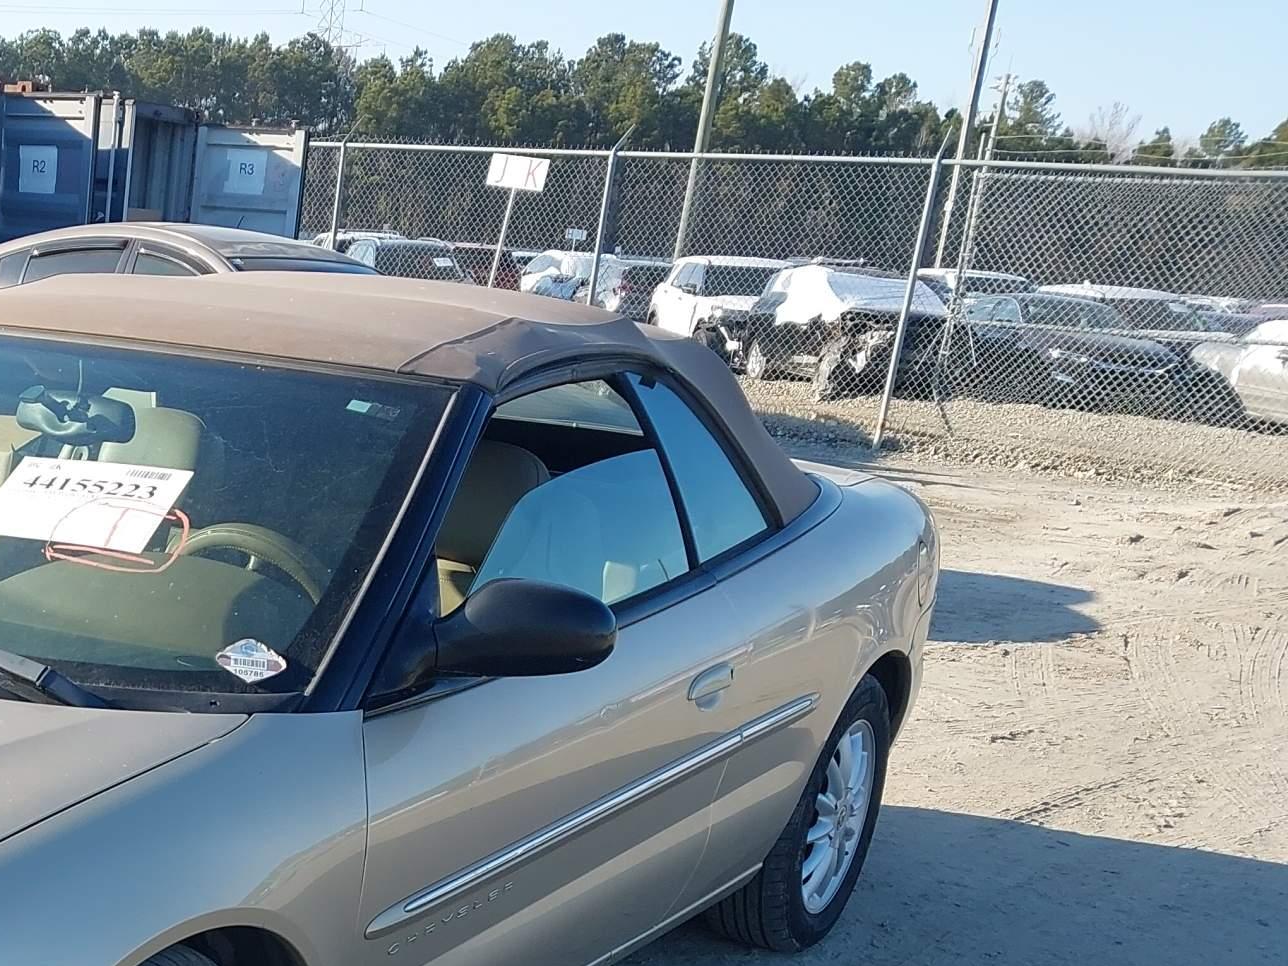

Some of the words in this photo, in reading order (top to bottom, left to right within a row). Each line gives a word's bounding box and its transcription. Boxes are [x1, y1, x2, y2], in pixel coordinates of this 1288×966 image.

[32, 159, 47, 173] R2
[239, 162, 255, 176] R3
[495, 156, 509, 183] J
[524, 159, 543, 188] K
[23, 474, 158, 500] 44155223
